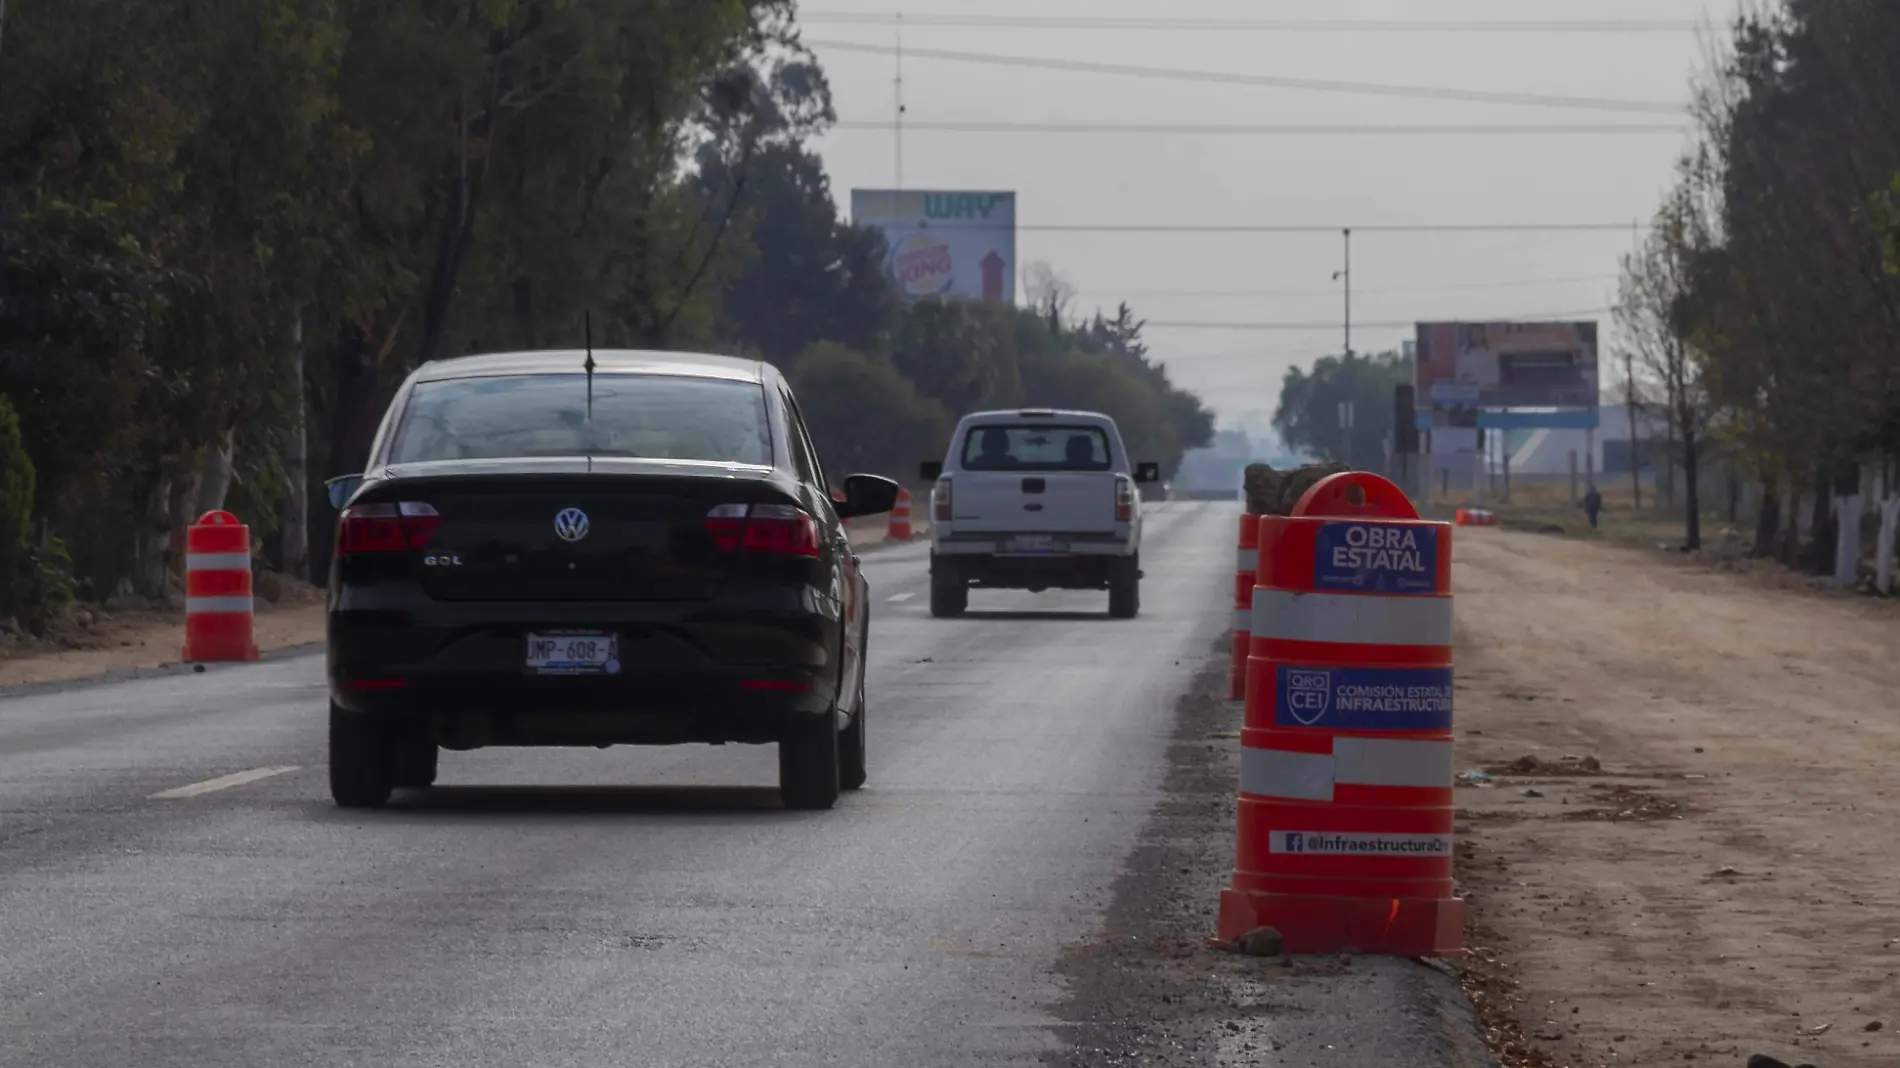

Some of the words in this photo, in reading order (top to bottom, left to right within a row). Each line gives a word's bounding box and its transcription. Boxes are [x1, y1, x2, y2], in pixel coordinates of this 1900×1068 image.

[1345, 526, 1417, 550] OBRA
[424, 555, 463, 567] GOL
[1333, 546, 1425, 572] ESTATAL
[1291, 674, 1326, 688] QRO
[1336, 684, 1405, 698] COMISIÓN
[1291, 691, 1324, 709] CEI
